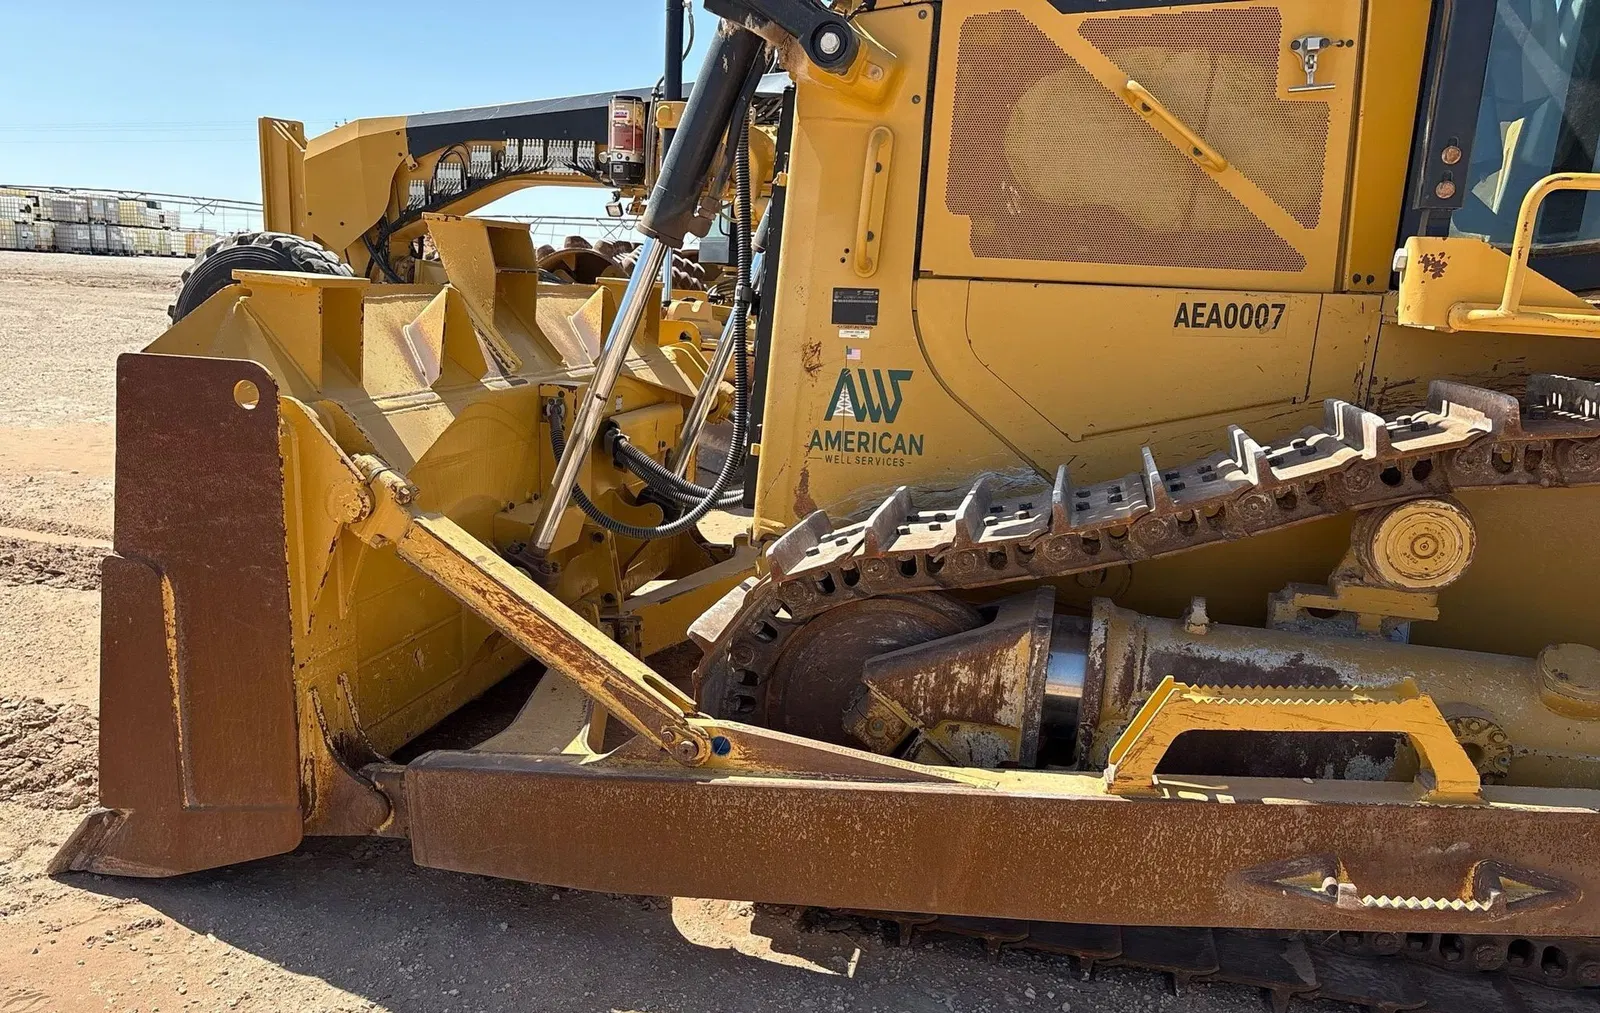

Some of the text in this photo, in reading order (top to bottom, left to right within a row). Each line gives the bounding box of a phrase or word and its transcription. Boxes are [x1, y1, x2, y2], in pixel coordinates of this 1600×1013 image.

[1173, 302, 1286, 330] AEA0007
[809, 429, 924, 456] AMERICAN
[825, 454, 905, 467] WELL SERVICES
